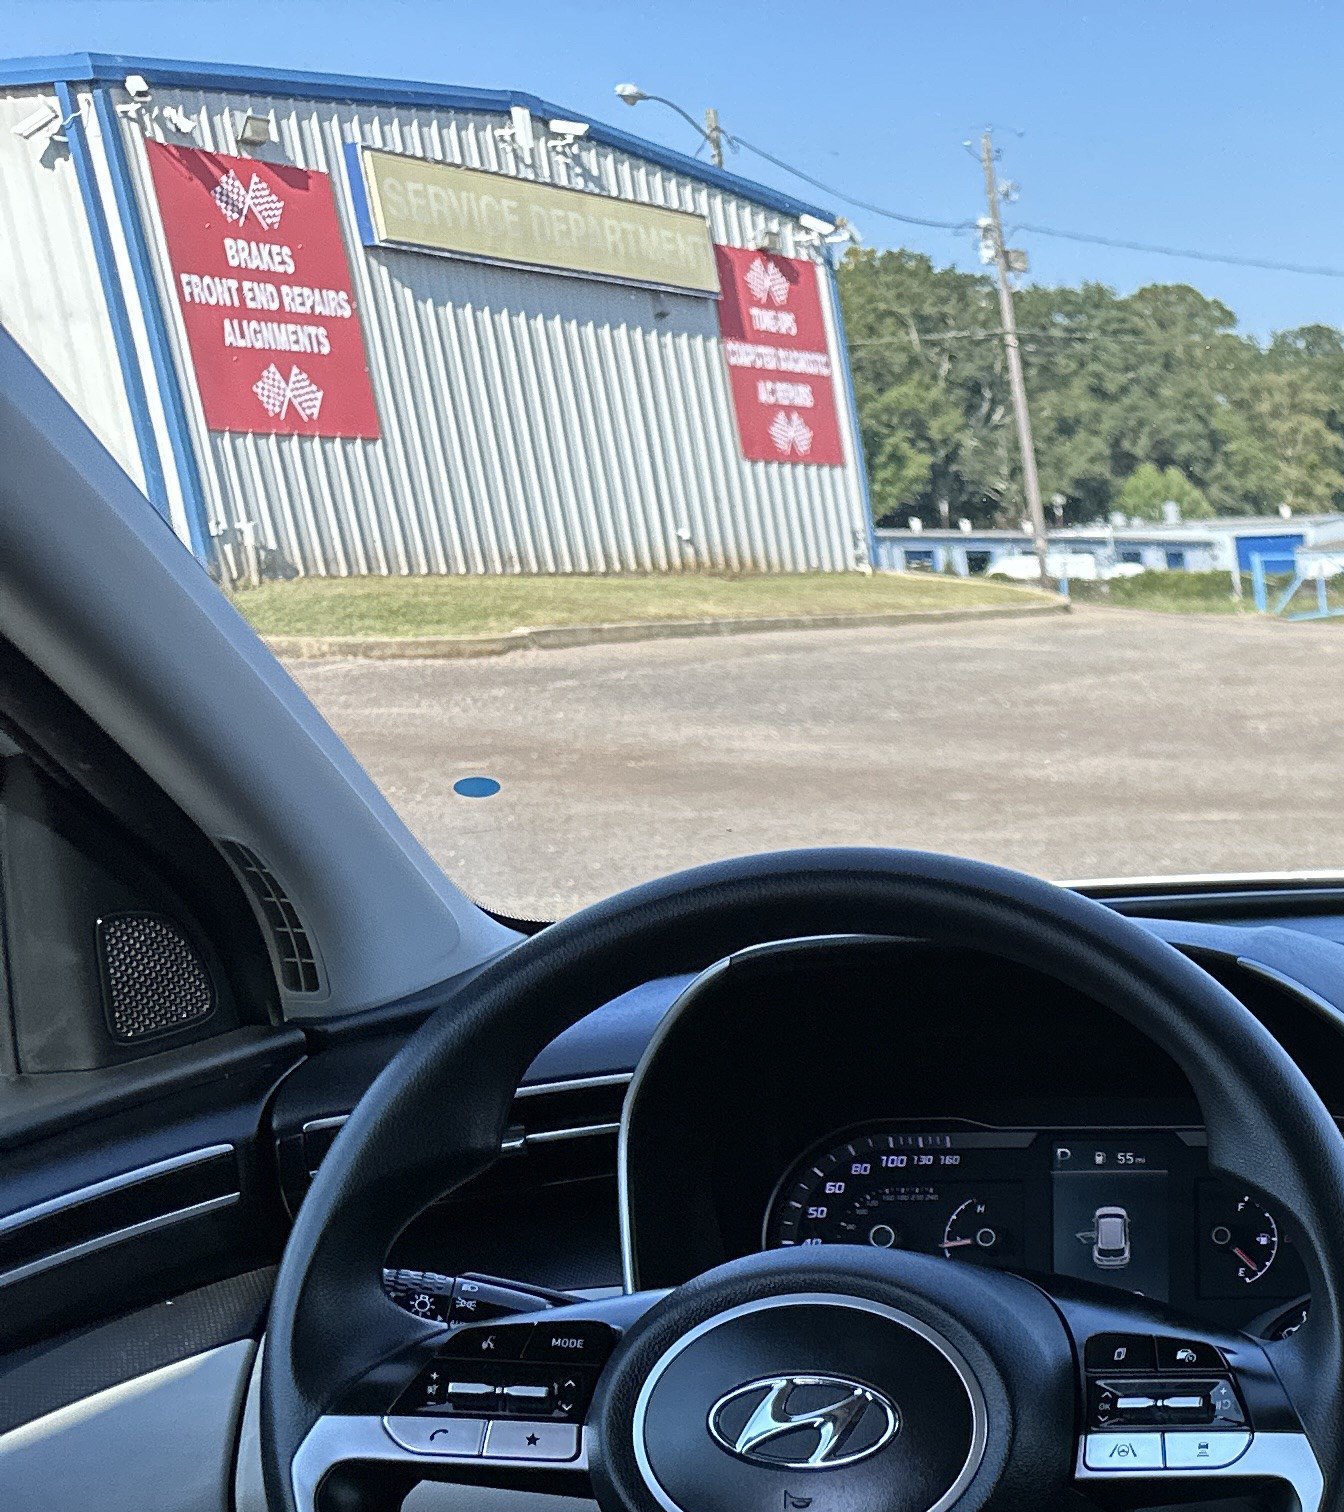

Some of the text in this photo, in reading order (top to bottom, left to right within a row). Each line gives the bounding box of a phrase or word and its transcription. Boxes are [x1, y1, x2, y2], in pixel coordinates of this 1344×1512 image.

[383, 177, 520, 237] SERVICE
[223, 237, 295, 275] BRAKES
[180, 273, 352, 319] FRONT END REPAIRS
[223, 318, 331, 355] ALIGNMENTS
[1057, 1148, 1071, 1161] P
[1117, 1152, 1135, 1164] 55
[881, 1155, 961, 1168] 100 130 160
[851, 1163, 871, 1175] 80
[825, 1182, 845, 1194] 60
[807, 1206, 827, 1218] 50
[976, 1204, 985, 1213] H
[1237, 1203, 1245, 1212] F
[1238, 1268, 1246, 1277] E
[551, 1337, 585, 1349] MODE
